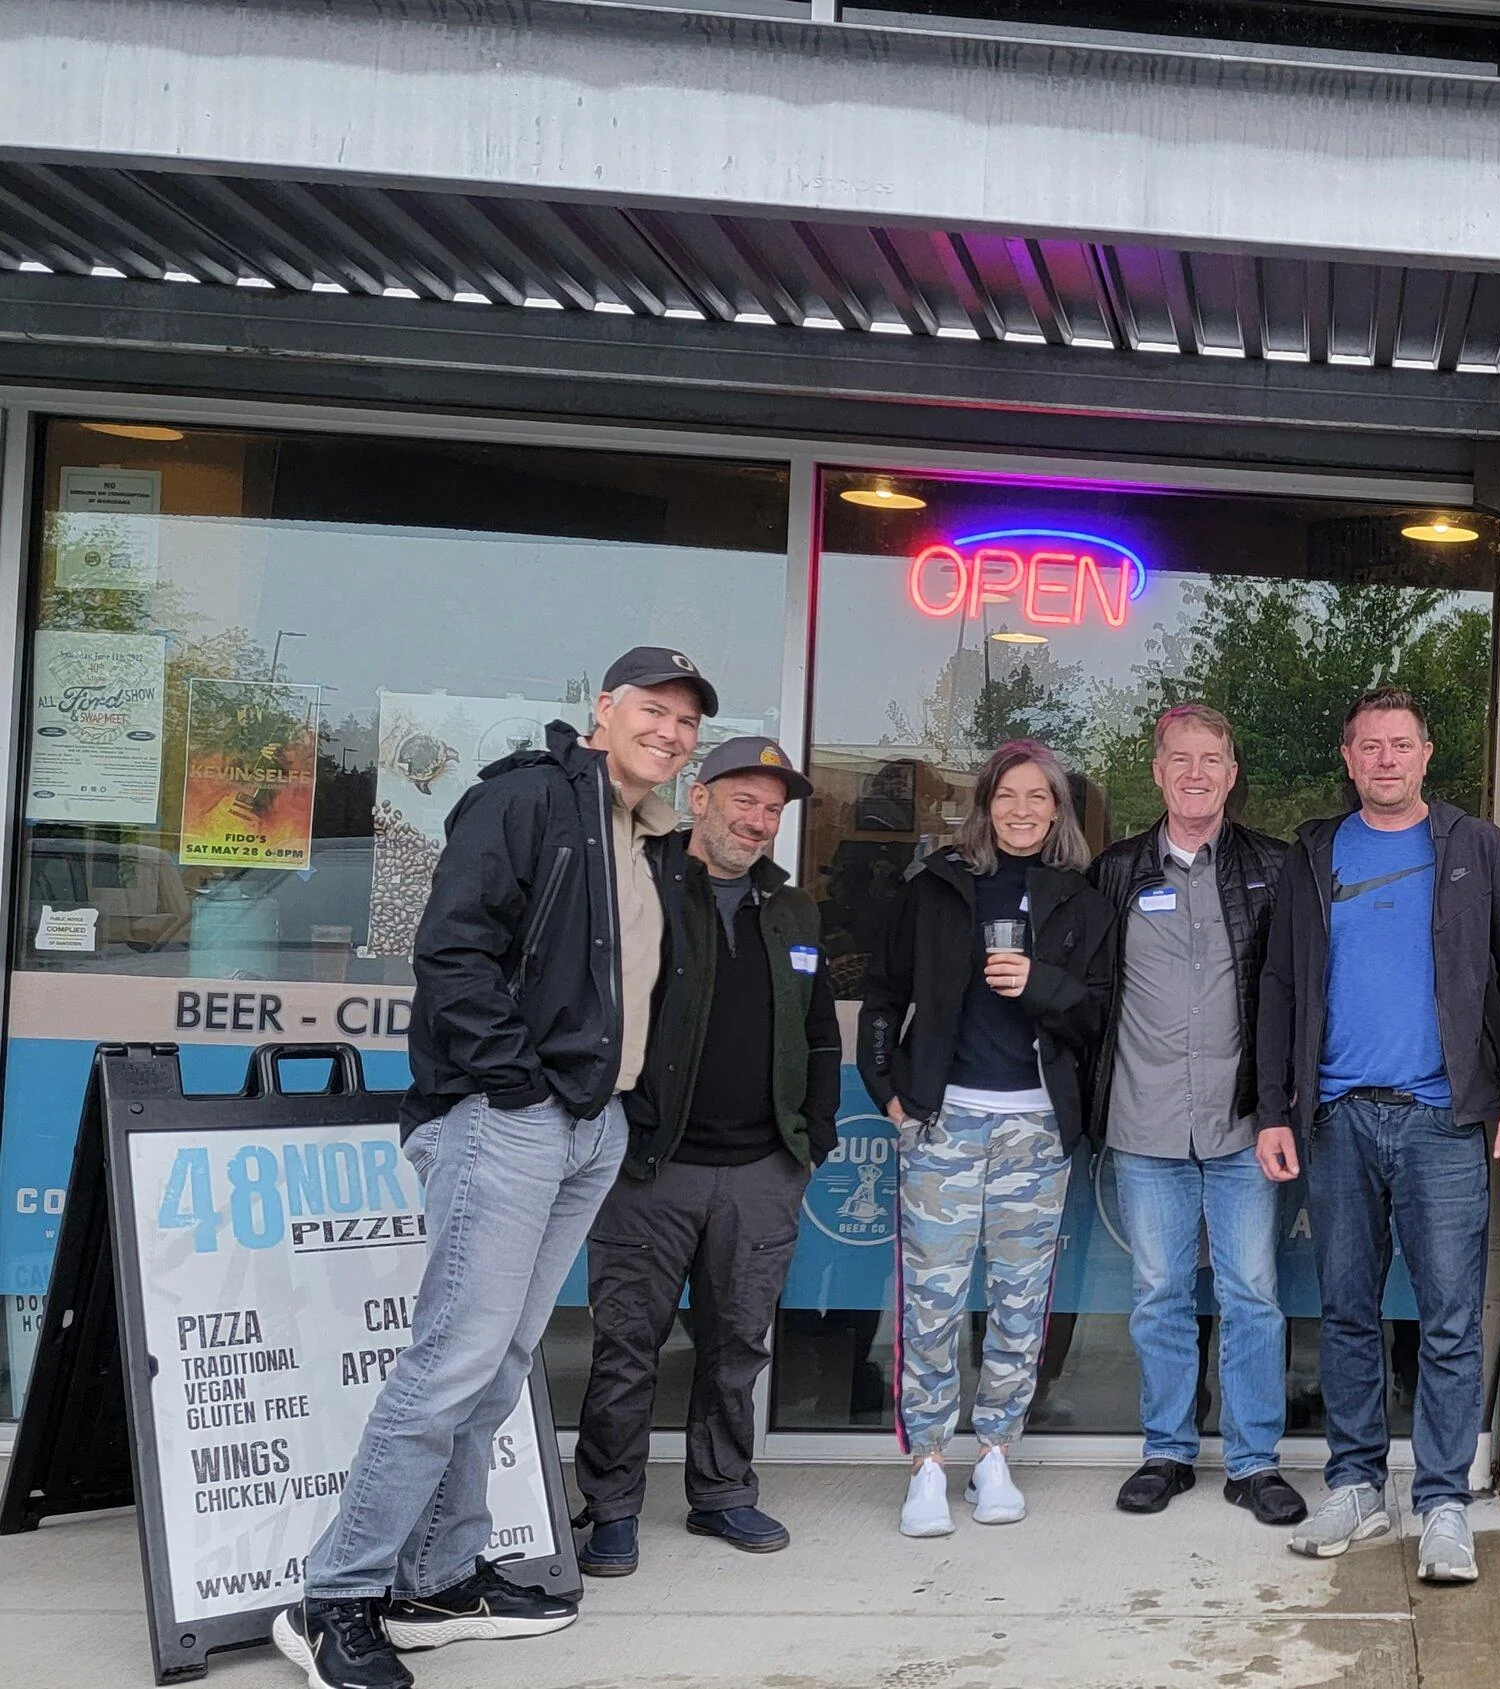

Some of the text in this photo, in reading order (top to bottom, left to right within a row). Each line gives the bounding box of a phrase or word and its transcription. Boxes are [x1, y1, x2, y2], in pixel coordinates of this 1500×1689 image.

[909, 544, 1131, 627] OPEN
[38, 685, 156, 713] ALL Ford SHOW
[70, 709, 127, 725] & SWAP MEET
[189, 764, 250, 782] KEVIN
[186, 844, 304, 859] SAT MAY 28 6-8PM
[225, 833, 267, 844] FIDO'S
[46, 925, 87, 933] COMPLIED
[175, 990, 285, 1033] BEER
[281, 1139, 426, 1217] NOR
[838, 1223, 866, 1234] BEER
[177, 1309, 264, 1351] PIZZA
[181, 1347, 301, 1381] TRADITIONAL
[183, 1377, 247, 1406] VEGAN
[186, 1394, 310, 1431] GLUTEN FREE
[190, 1437, 291, 1486] WINGS
